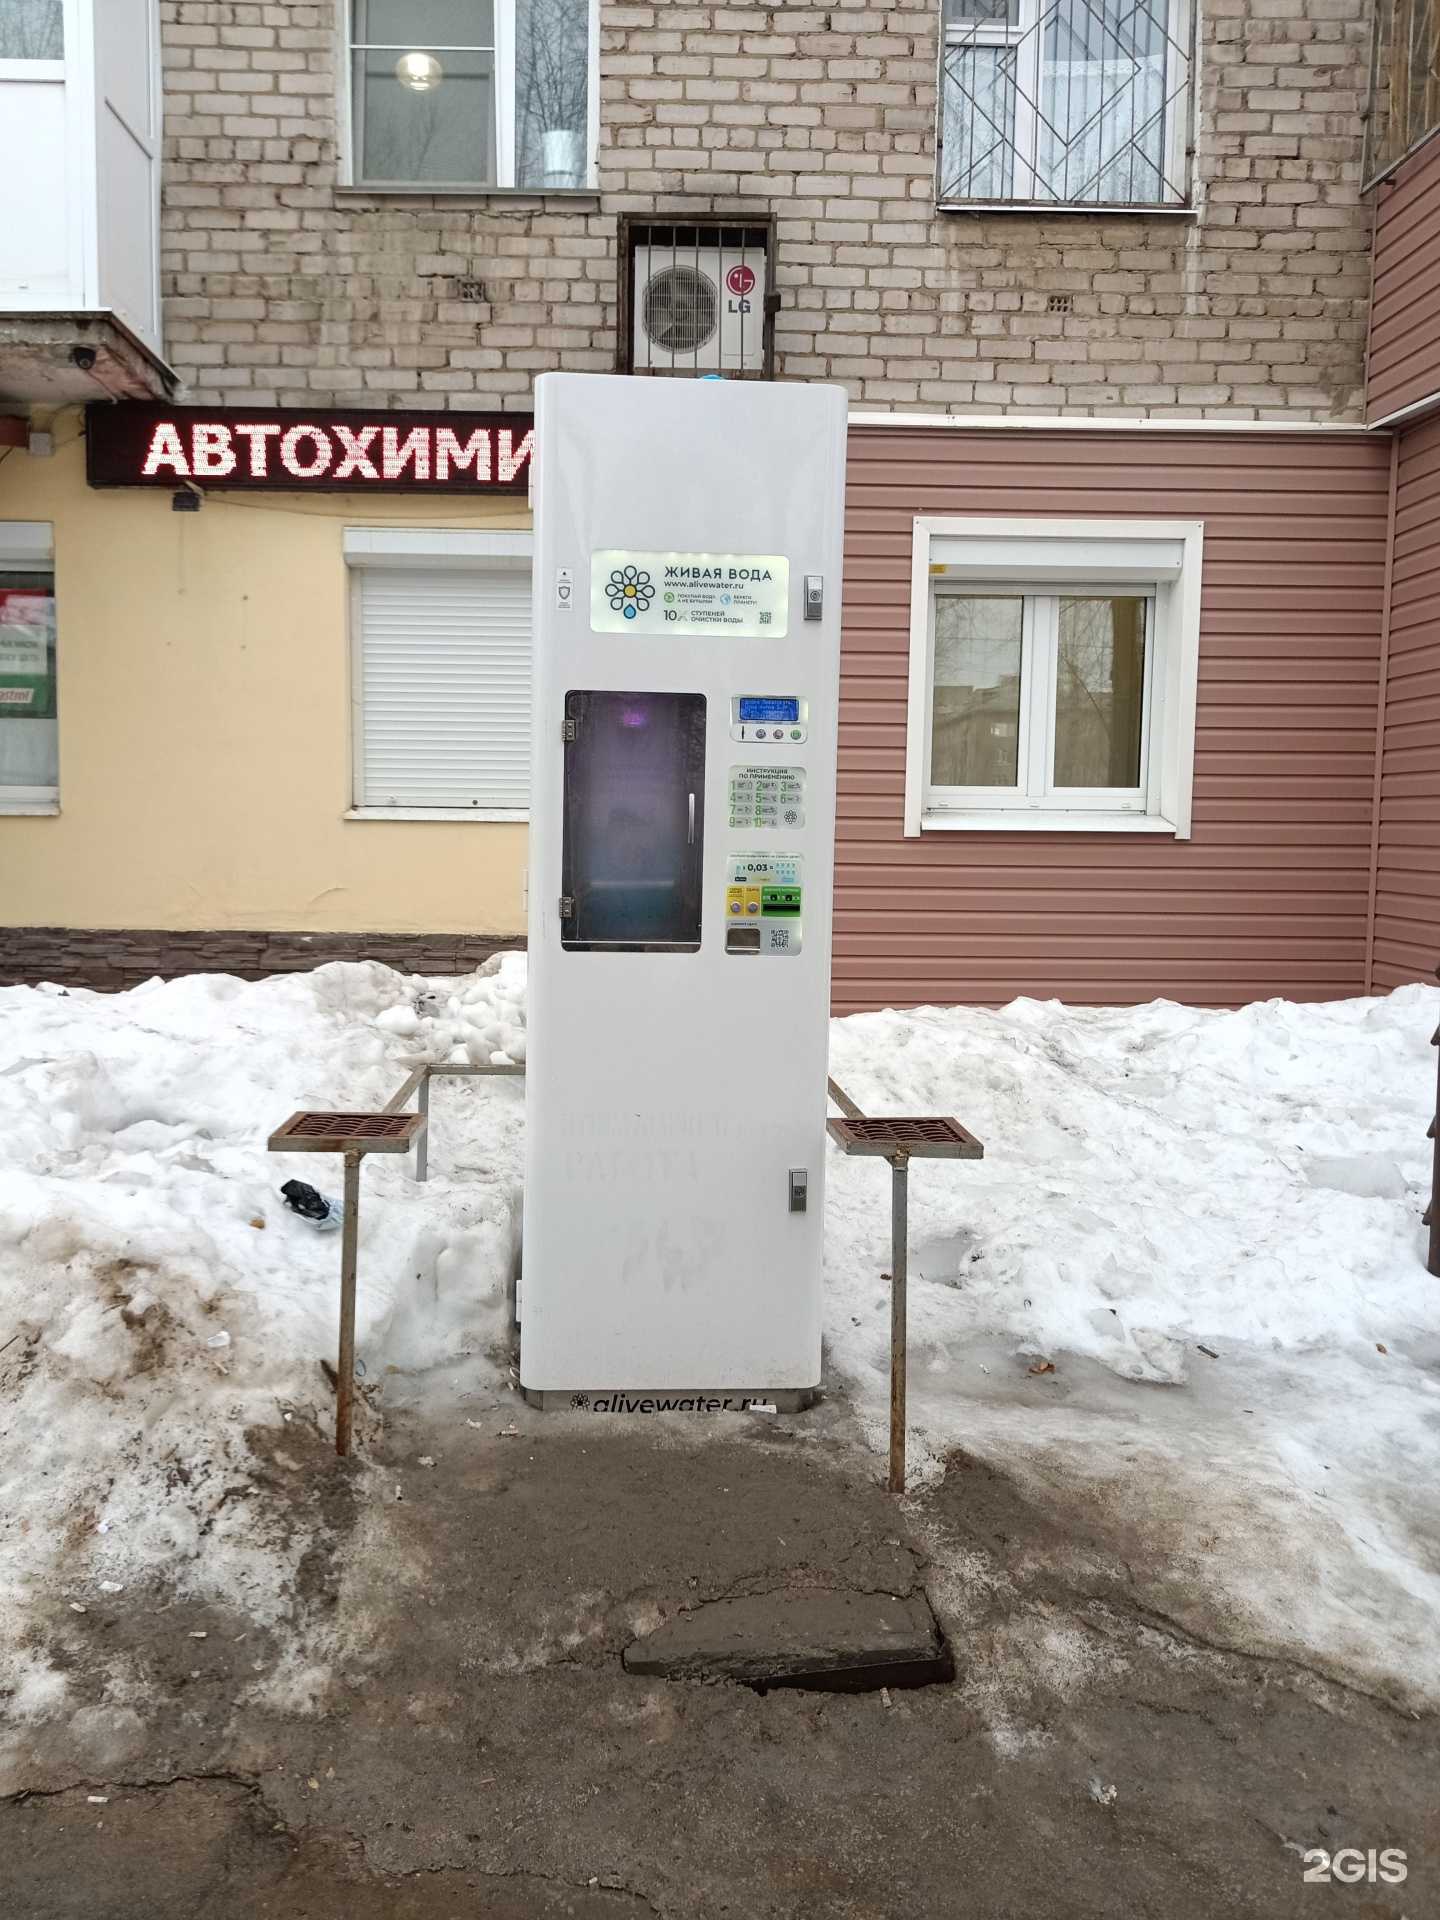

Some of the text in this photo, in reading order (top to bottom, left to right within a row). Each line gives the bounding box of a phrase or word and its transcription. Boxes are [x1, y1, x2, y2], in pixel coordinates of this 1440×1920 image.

[728, 300, 751, 313] LG
[141, 423, 535, 481] АВТОХИМИ
[664, 566, 772, 582] ЖИВАЯ ВОДА
[664, 580, 744, 589] www.alivewater.ru
[663, 610, 677, 621] 10
[690, 609, 725, 617] СТУПЕНЕЙ
[747, 863, 768, 873] 0,03
